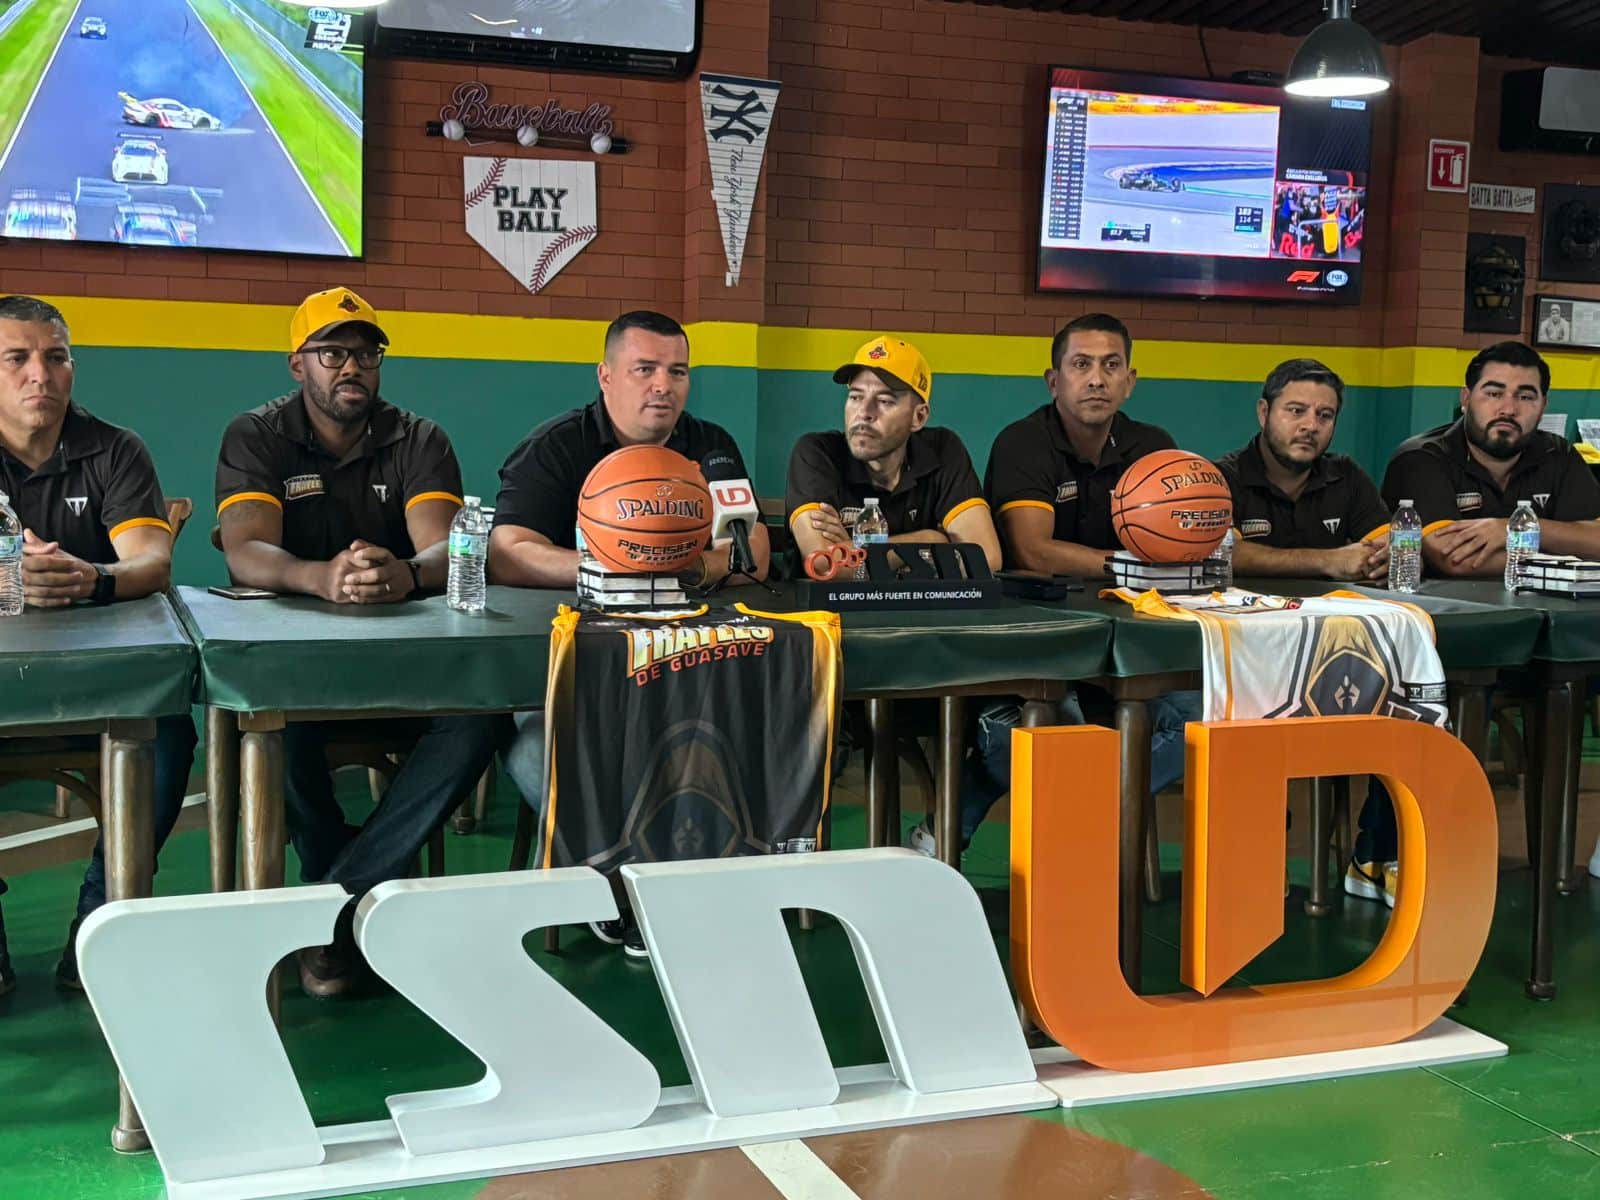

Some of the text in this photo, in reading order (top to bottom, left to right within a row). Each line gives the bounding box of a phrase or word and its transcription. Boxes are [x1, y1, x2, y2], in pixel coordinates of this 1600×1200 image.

[440, 81, 613, 136] Baseball
[493, 185, 569, 210] PLAY
[497, 210, 567, 233] BALL
[618, 498, 704, 520] SPALDING
[618, 539, 698, 554] PRECISION
[829, 593, 838, 601] EL
[839, 592, 865, 601] GRUPO
[866, 590, 884, 600] MÁS
[885, 592, 911, 600] FUERTE
[924, 588, 982, 599] COMUNICACIÓN
[635, 642, 766, 687] DE GUASAVE
